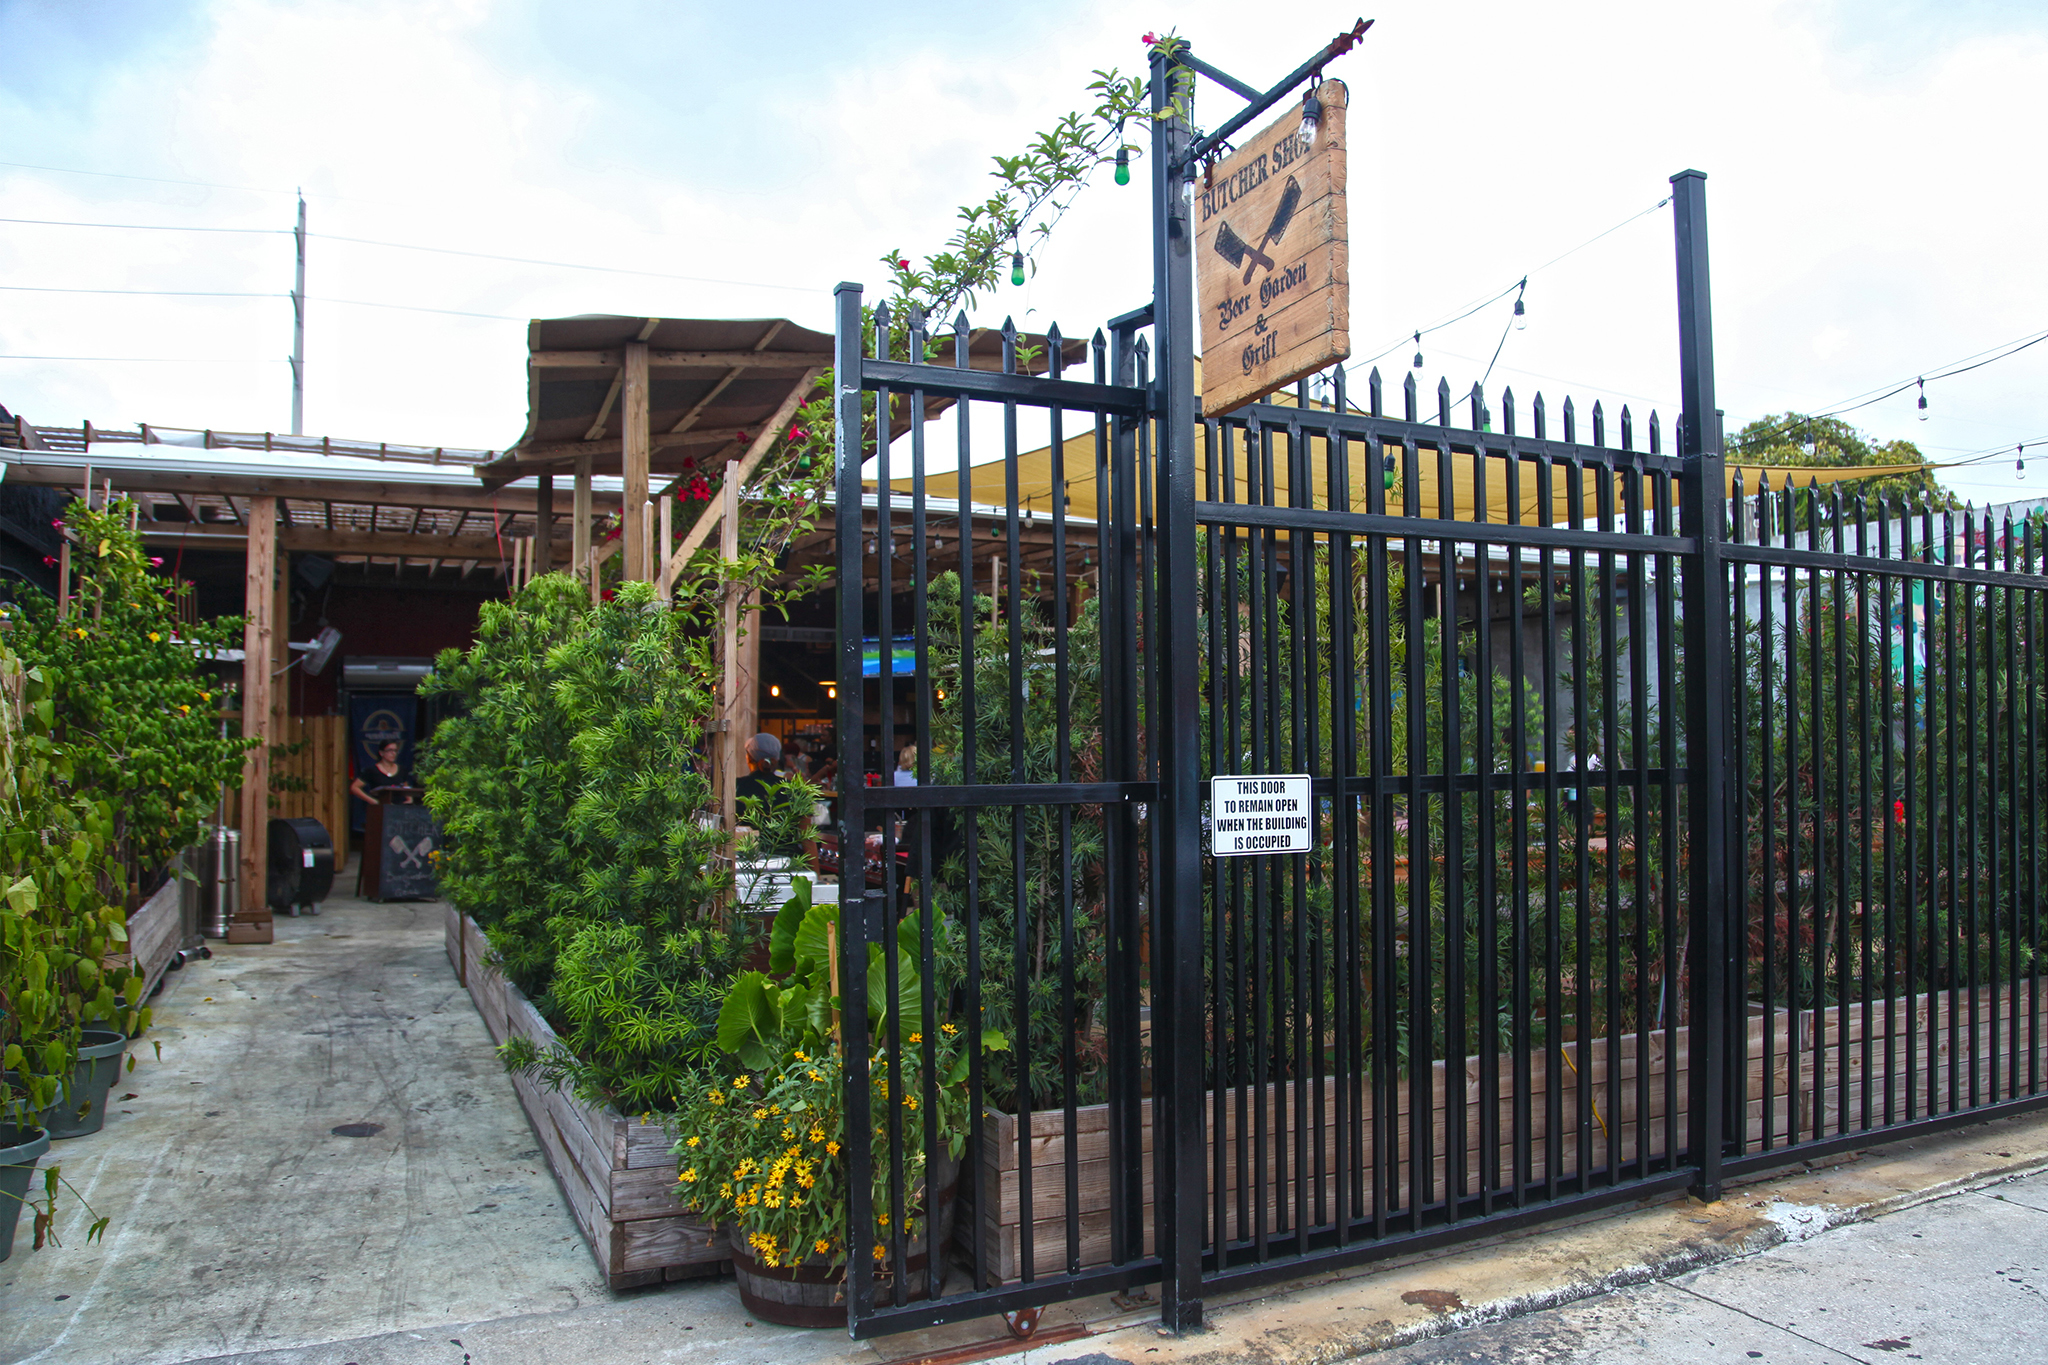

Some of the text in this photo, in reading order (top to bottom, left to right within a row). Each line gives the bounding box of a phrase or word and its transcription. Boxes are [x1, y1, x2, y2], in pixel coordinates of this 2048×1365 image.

[1202, 133, 1310, 222] BUTCHER SHO
[1217, 262, 1307, 331] Beer Garden
[1255, 313, 1268, 336] &
[1242, 330, 1278, 376] Grill
[1237, 781, 1286, 795] THIS DOOR
[1224, 799, 1298, 813] TO REMAIN OPEN
[1217, 816, 1307, 832] WHEN THE BUILDING
[1234, 835, 1291, 850] IS OCCUPIED
